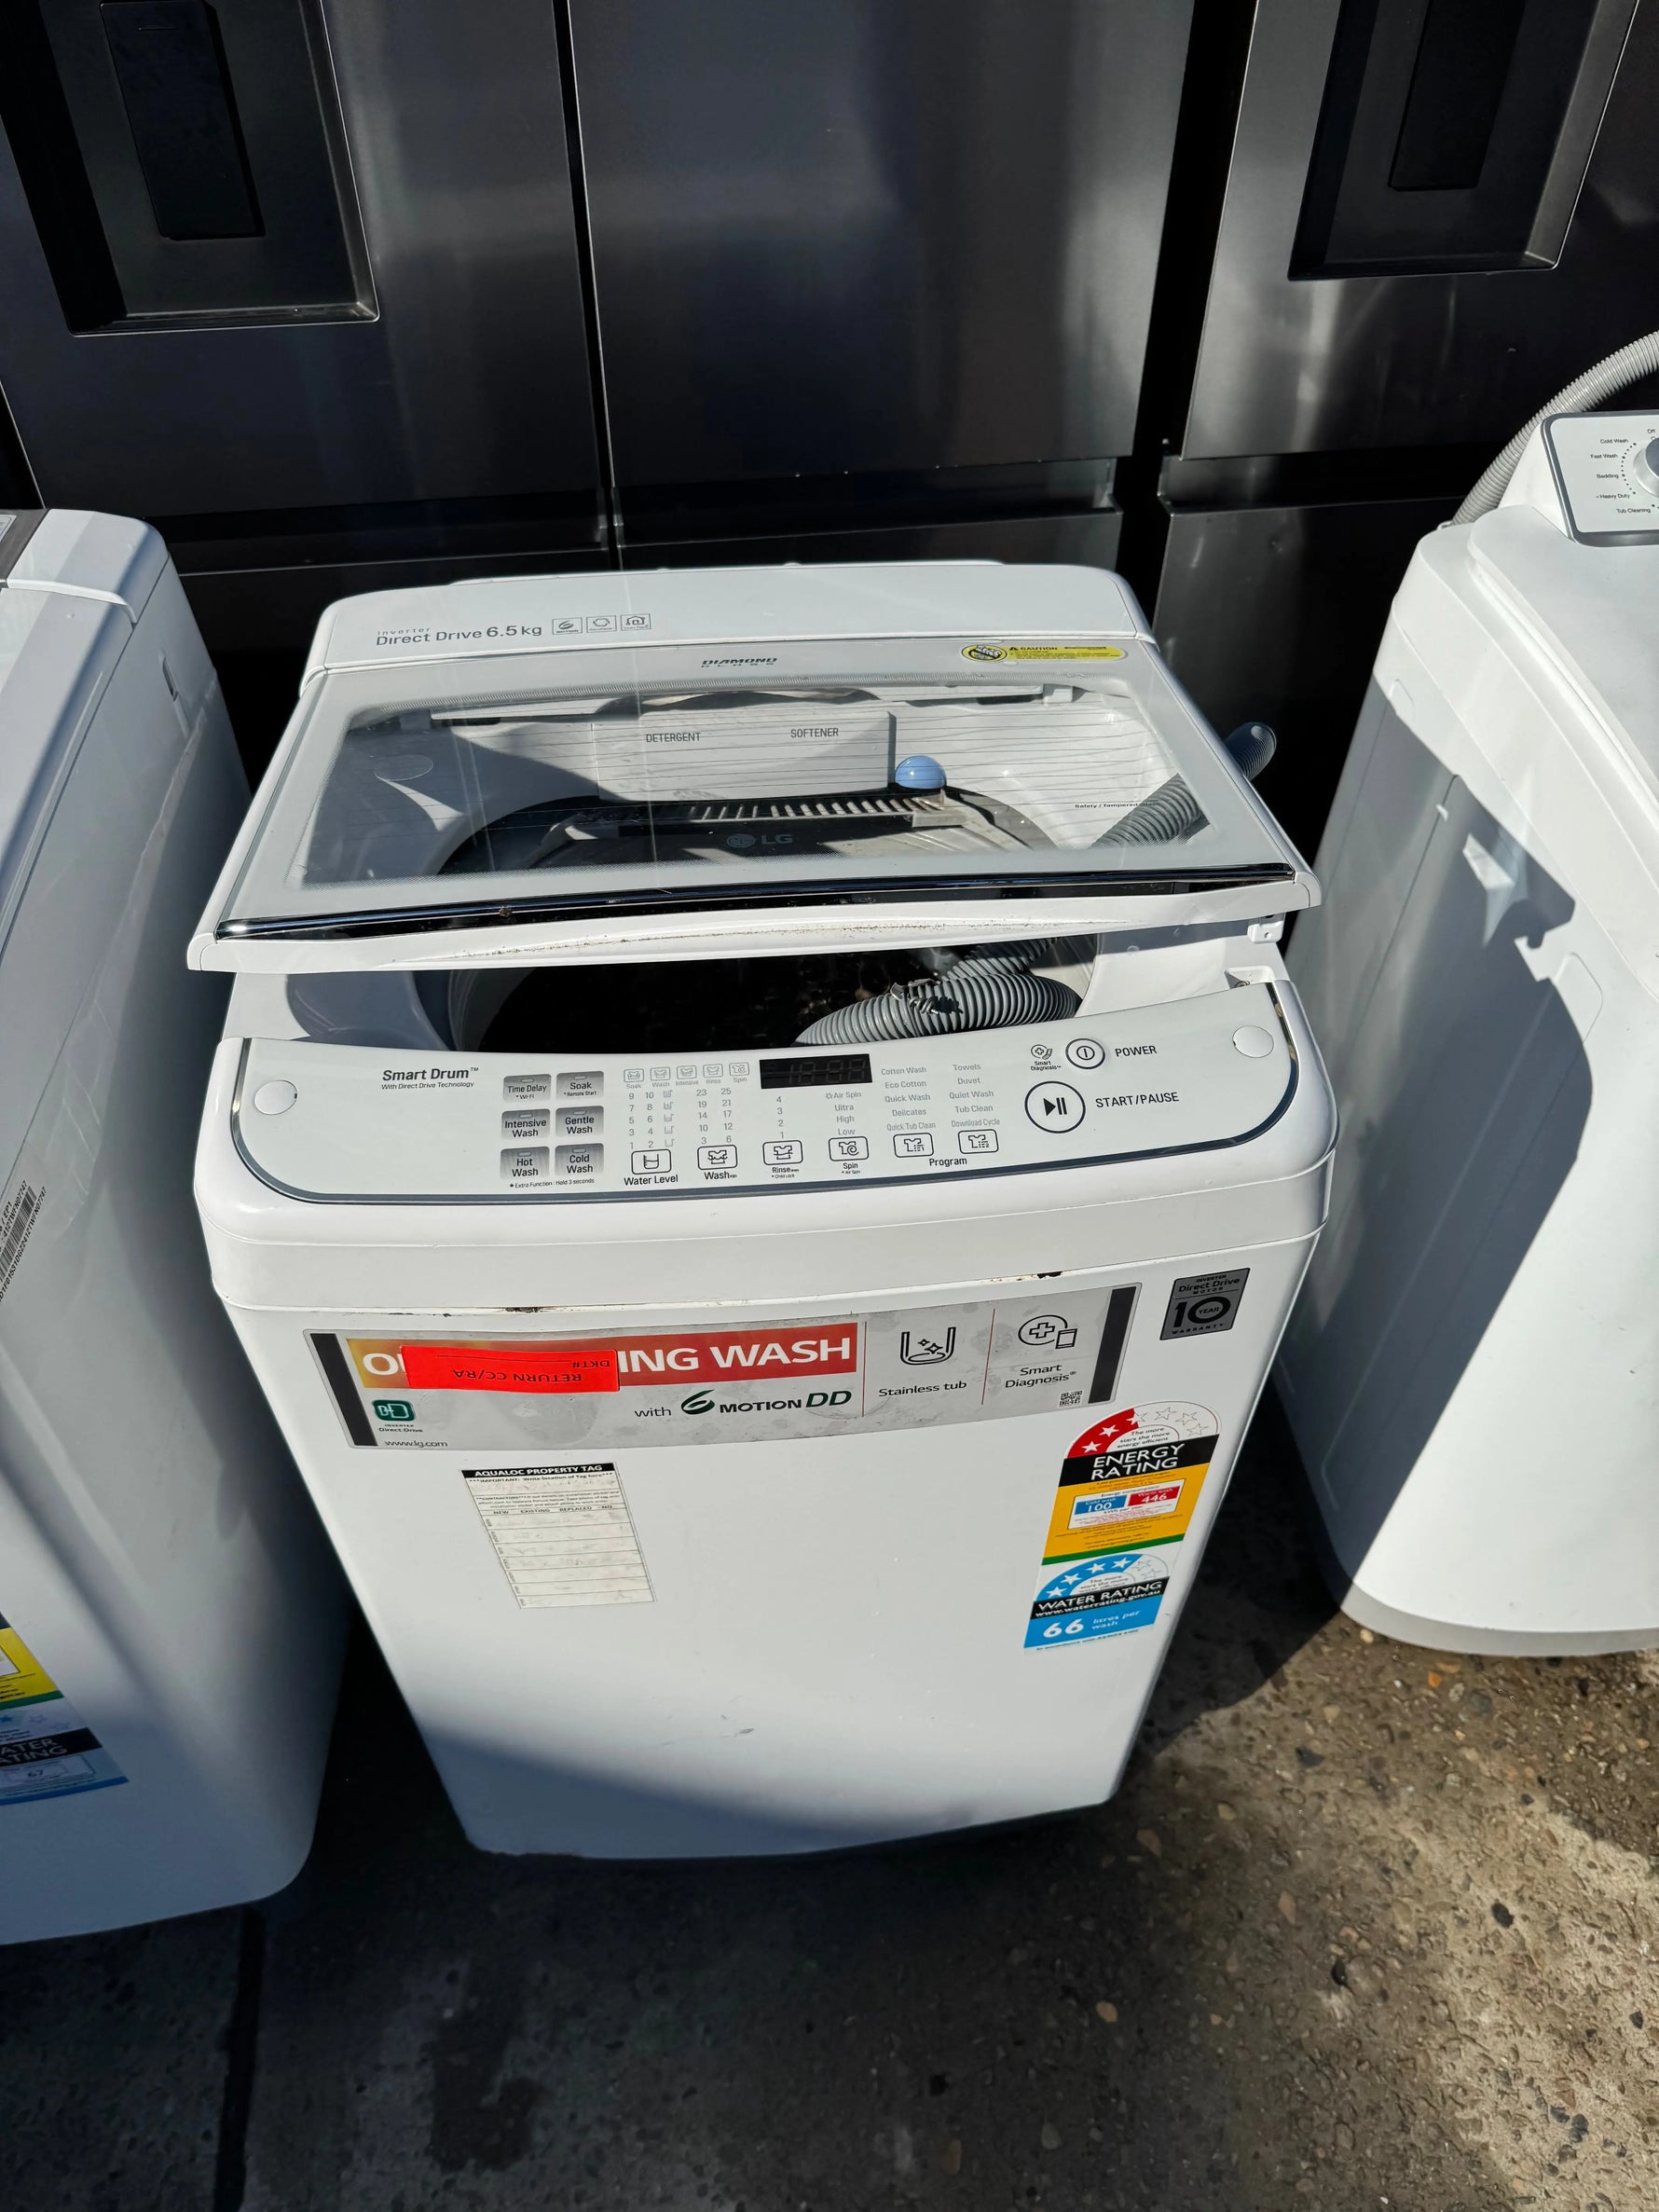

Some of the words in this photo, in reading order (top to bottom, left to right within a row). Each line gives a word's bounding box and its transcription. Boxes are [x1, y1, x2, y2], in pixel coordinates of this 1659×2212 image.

[377, 626, 431, 635] inverter
[377, 632, 431, 646] Direct
[435, 629, 482, 642] Drive
[486, 625, 517, 638] 6.5
[521, 625, 542, 637] kg
[646, 732, 701, 743] DETERGENT
[790, 727, 839, 738] SOFTENER
[761, 833, 793, 845] LG
[1115, 1045, 1158, 1057] POWER
[382, 1069, 427, 1081] Smart
[507, 1085, 525, 1093] Time
[527, 1084, 547, 1093] Delay
[569, 1081, 592, 1090] Soak
[1095, 1092, 1180, 1108] START/PAUSE
[892, 1108, 927, 1117] Delicates
[504, 1119, 547, 1129] Intensive
[565, 1116, 595, 1125] Gentle
[836, 1115, 855, 1123] High
[951, 1120, 982, 1128] Download
[567, 1125, 594, 1135] Wash
[724, 1122, 734, 1131] 12
[513, 1129, 539, 1138] Wash
[516, 1158, 533, 1167] Hot
[569, 1154, 590, 1163] Cold
[928, 1157, 967, 1167] Program
[567, 1164, 594, 1174] Wash
[843, 1162, 858, 1171] Spin
[512, 1168, 539, 1177] Wash
[704, 1171, 730, 1180] Wash
[624, 1176, 651, 1186] Water
[654, 1175, 679, 1184] Level
[1197, 1274, 1227, 1283] INVERTER
[1178, 1283, 1210, 1292] Direct
[1213, 1278, 1241, 1287] Drive
[1173, 1297, 1231, 1327] 10
[1172, 1323, 1224, 1334] WARRANTY
[709, 1337, 850, 1368] WASH
[571, 1359, 610, 1368] DKT#
[453, 1368, 507, 1381] CC/RA
[1020, 1365, 1063, 1376] Smart
[513, 1372, 583, 1382] RETURN
[879, 1382, 941, 1397] Stainless
[943, 1380, 967, 1393] tub
[635, 1407, 672, 1417] with
[720, 1399, 802, 1413] MOTION
[805, 1390, 852, 1408] DD
[1142, 1436, 1169, 1445] efficient
[1093, 1443, 1186, 1468] ENERGY
[474, 1467, 526, 1477] AQUALOC
[527, 1465, 579, 1475] PROPERTY
[581, 1464, 603, 1473] TAG
[1090, 1457, 1178, 1480] RATING
[1141, 1494, 1167, 1504] 446
[1088, 1503, 1113, 1513] 100
[1038, 1595, 1095, 1611] WATER
[1101, 1581, 1162, 1600] RATING
[1035, 1589, 1160, 1617] www.waterrating.gov.au
[1043, 1617, 1084, 1638] 66
[1092, 1615, 1118, 1624] litres
[1122, 1610, 1141, 1619] per
[1091, 1621, 1118, 1630] wash
[0, 1738, 57, 1755] ATER
[0, 1745, 68, 1765] ATING
